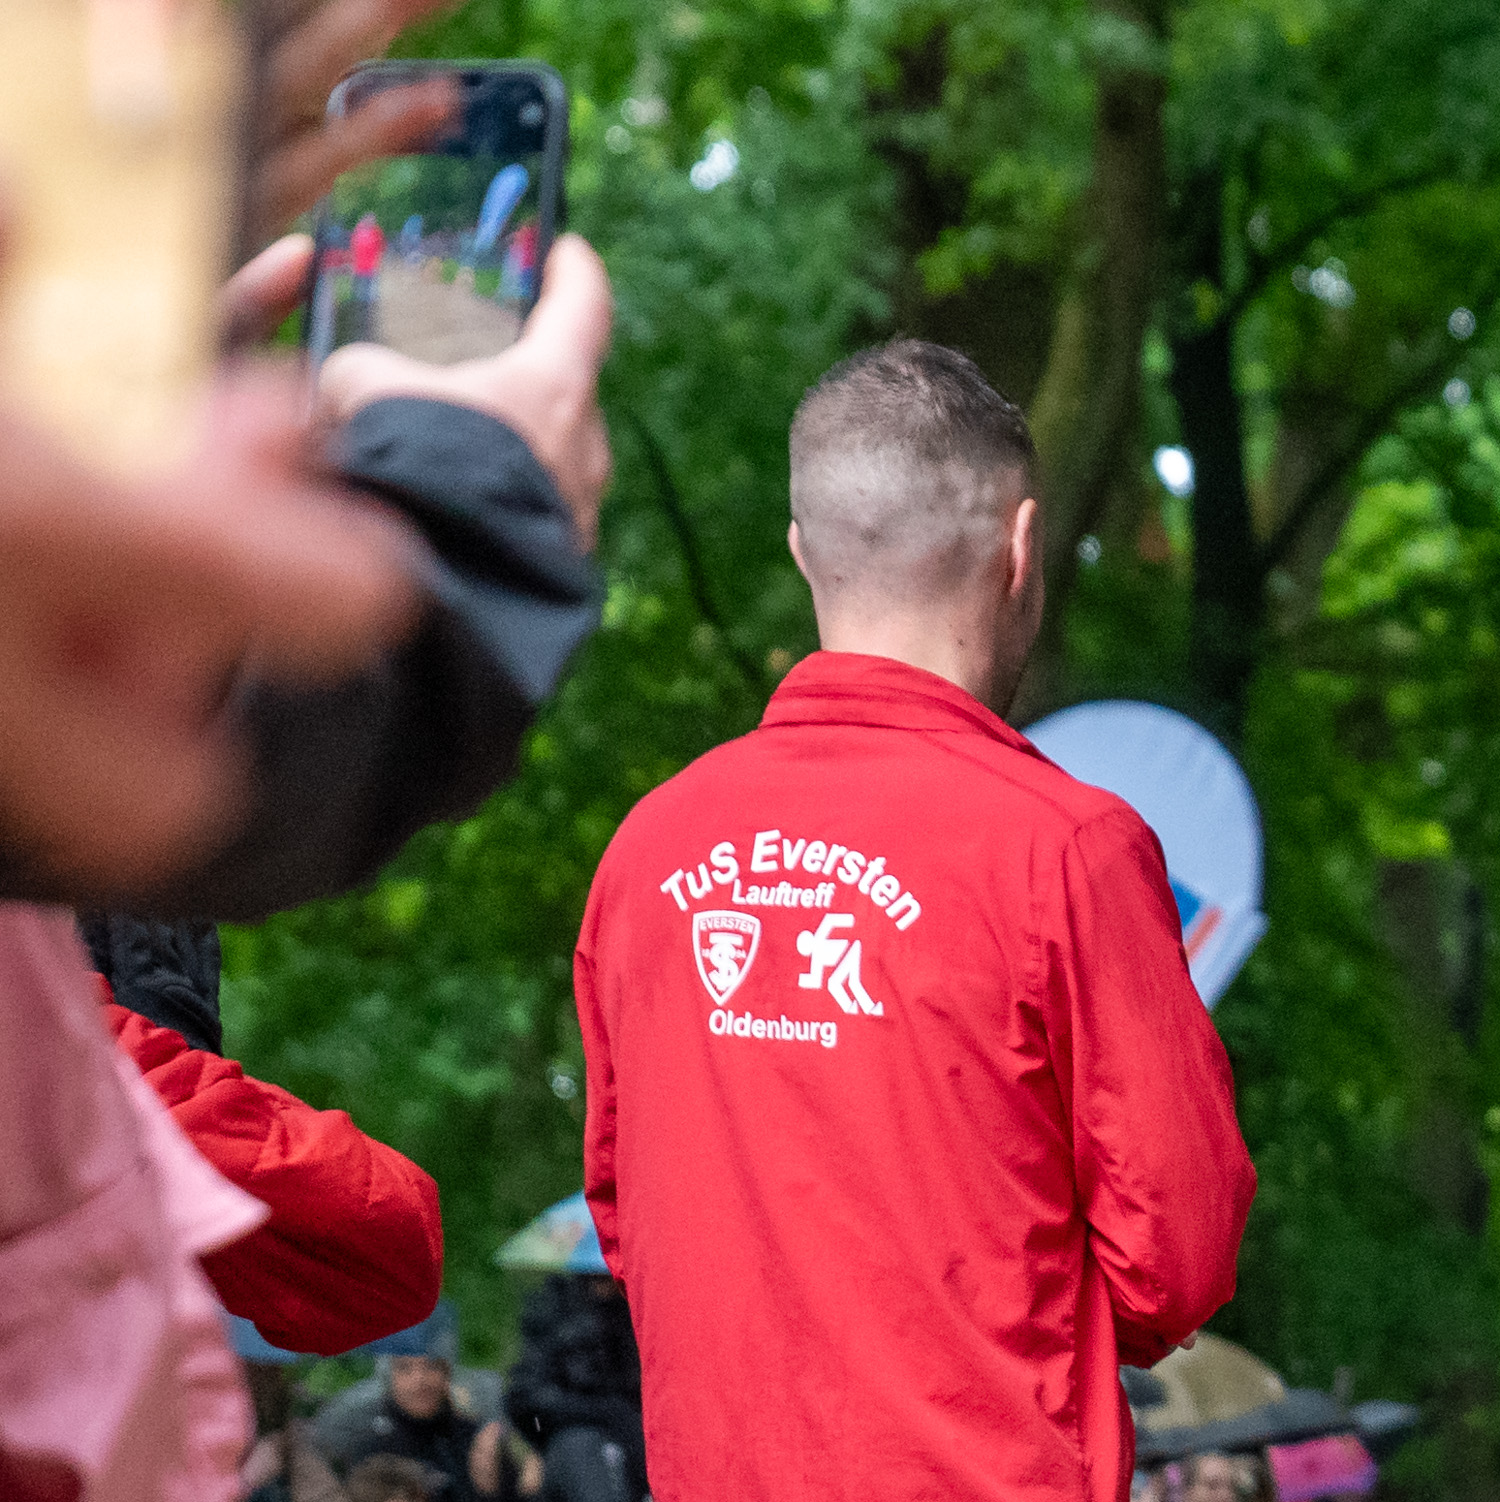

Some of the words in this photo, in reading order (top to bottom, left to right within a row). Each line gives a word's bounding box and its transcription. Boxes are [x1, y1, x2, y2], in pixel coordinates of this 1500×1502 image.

[659, 840, 739, 911] TuS
[750, 829, 922, 931] Eversten
[731, 879, 836, 908] Lauftreff
[699, 916, 754, 933] EVERSTEN
[708, 1009, 838, 1048] Oldenburg
